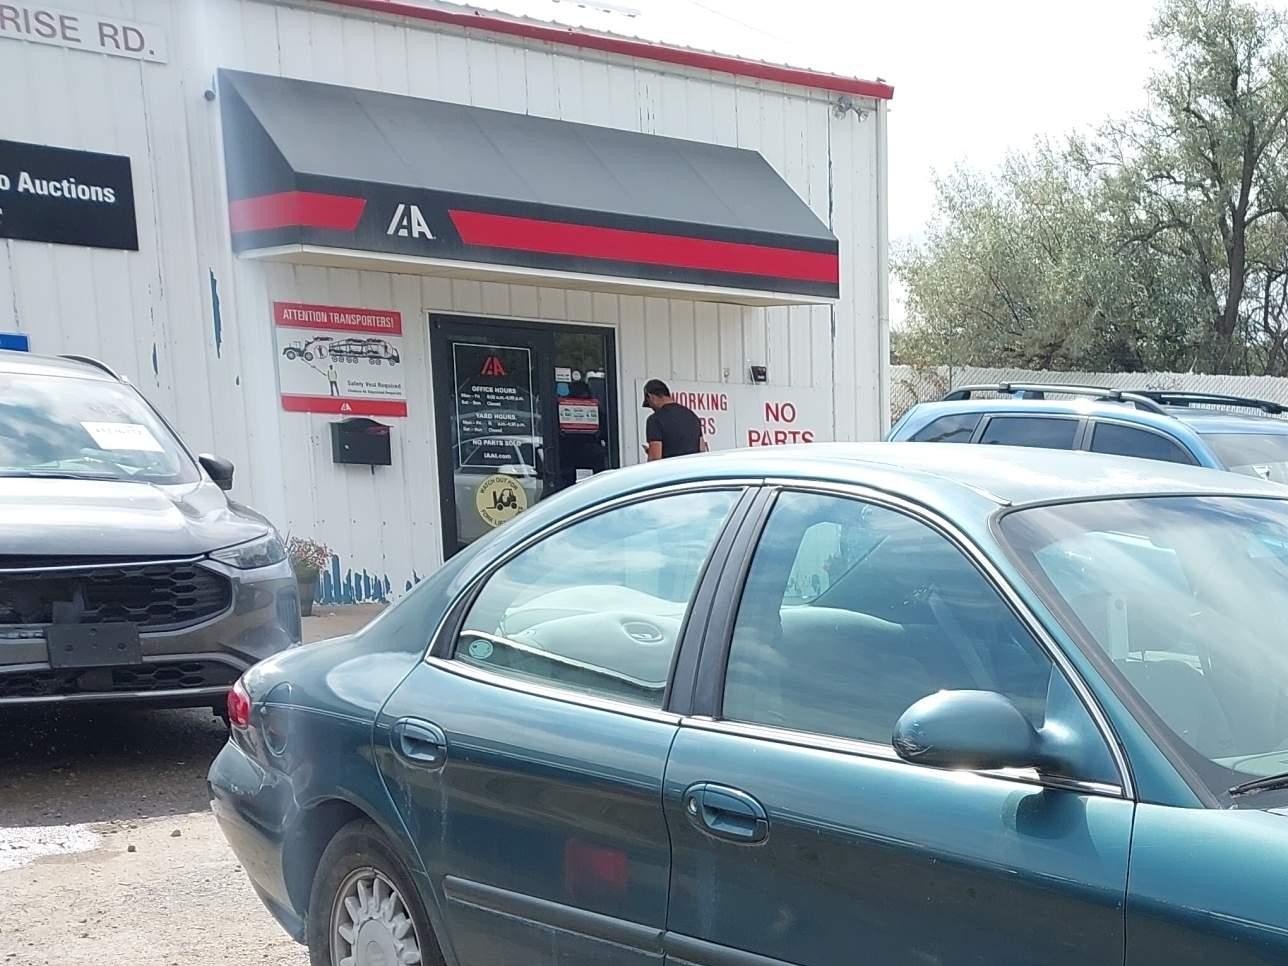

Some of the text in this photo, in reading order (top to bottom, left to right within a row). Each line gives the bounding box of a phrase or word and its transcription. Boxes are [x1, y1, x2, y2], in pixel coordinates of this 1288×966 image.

[98, 22, 155, 55] RD.
[17, 171, 116, 203] Auctions
[283, 308, 394, 328] ATTENTION TRANSPORTERS!
[764, 402, 797, 424] NO
[748, 430, 814, 448] PARTS
[480, 479, 496, 494] WATCH
[508, 480, 519, 491] FOR
[480, 509, 494, 523] FORK
